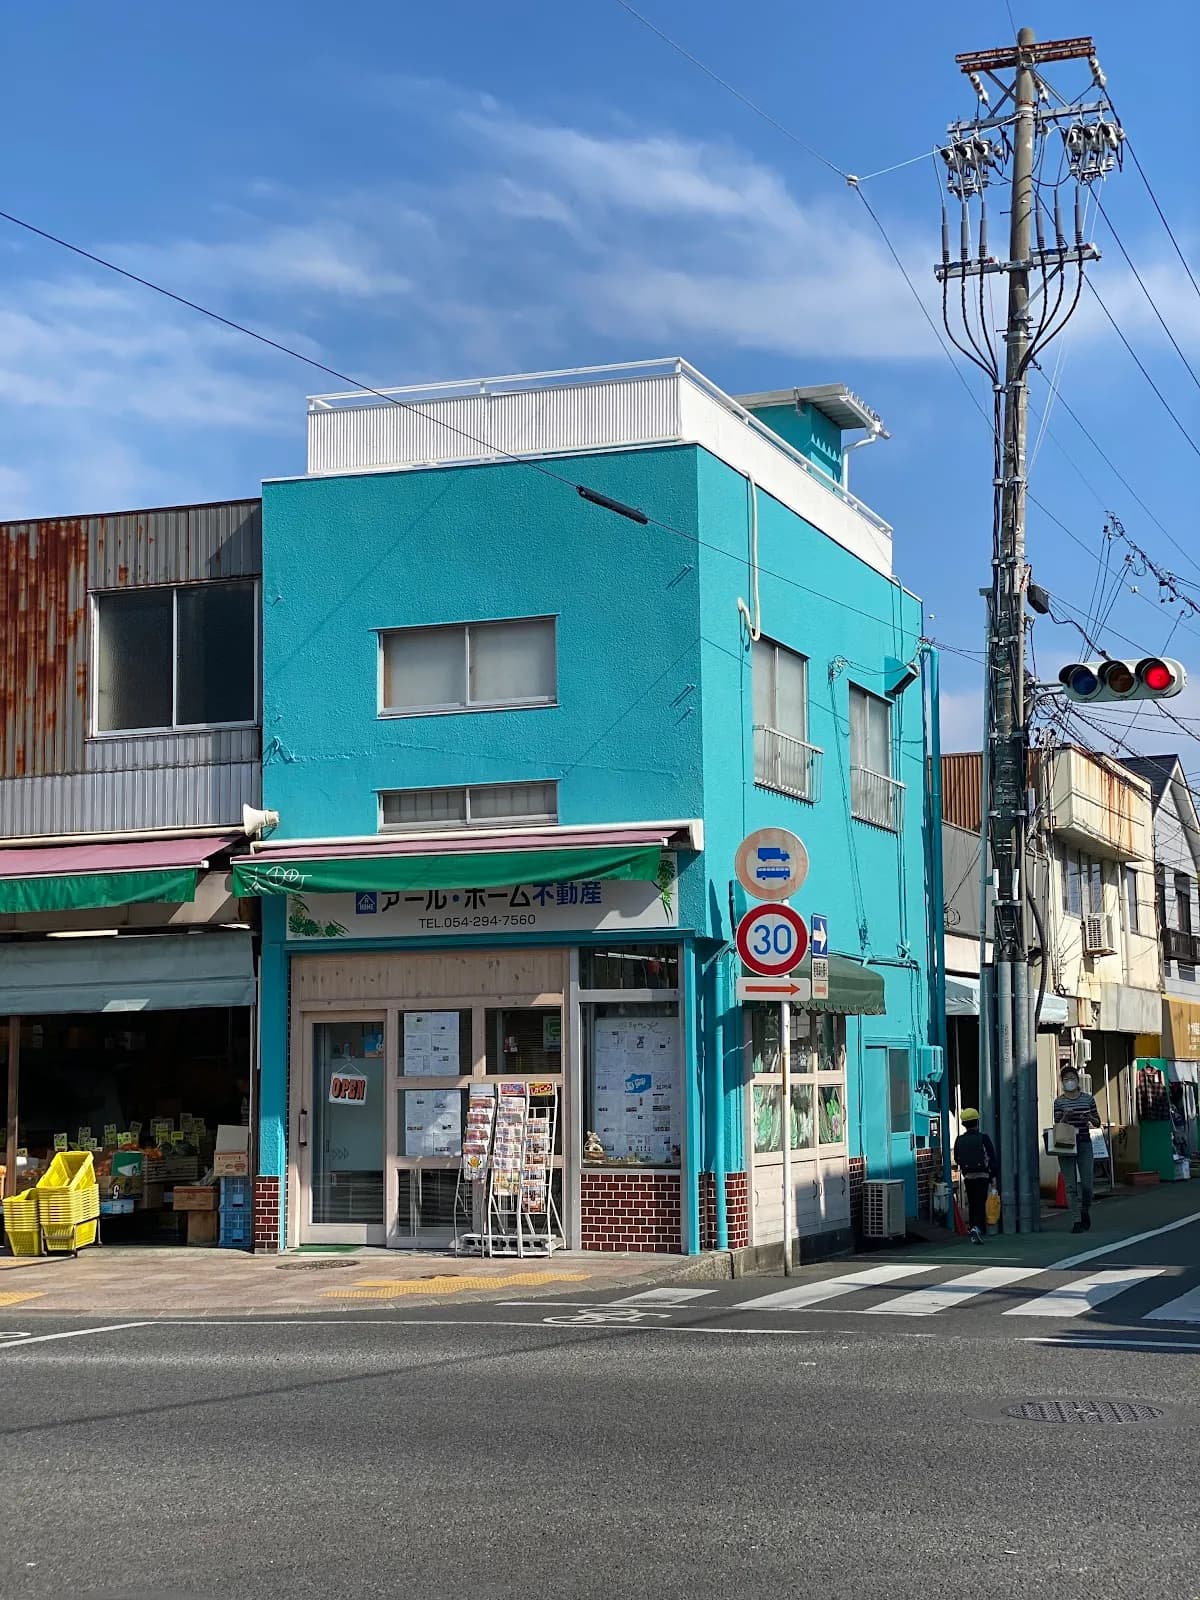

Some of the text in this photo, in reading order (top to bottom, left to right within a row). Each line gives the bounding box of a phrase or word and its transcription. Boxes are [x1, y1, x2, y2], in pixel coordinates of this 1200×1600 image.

[419, 914, 536, 929] TEL.054-294-7560
[753, 924, 793, 955] 30
[332, 1077, 366, 1100] OPEN
